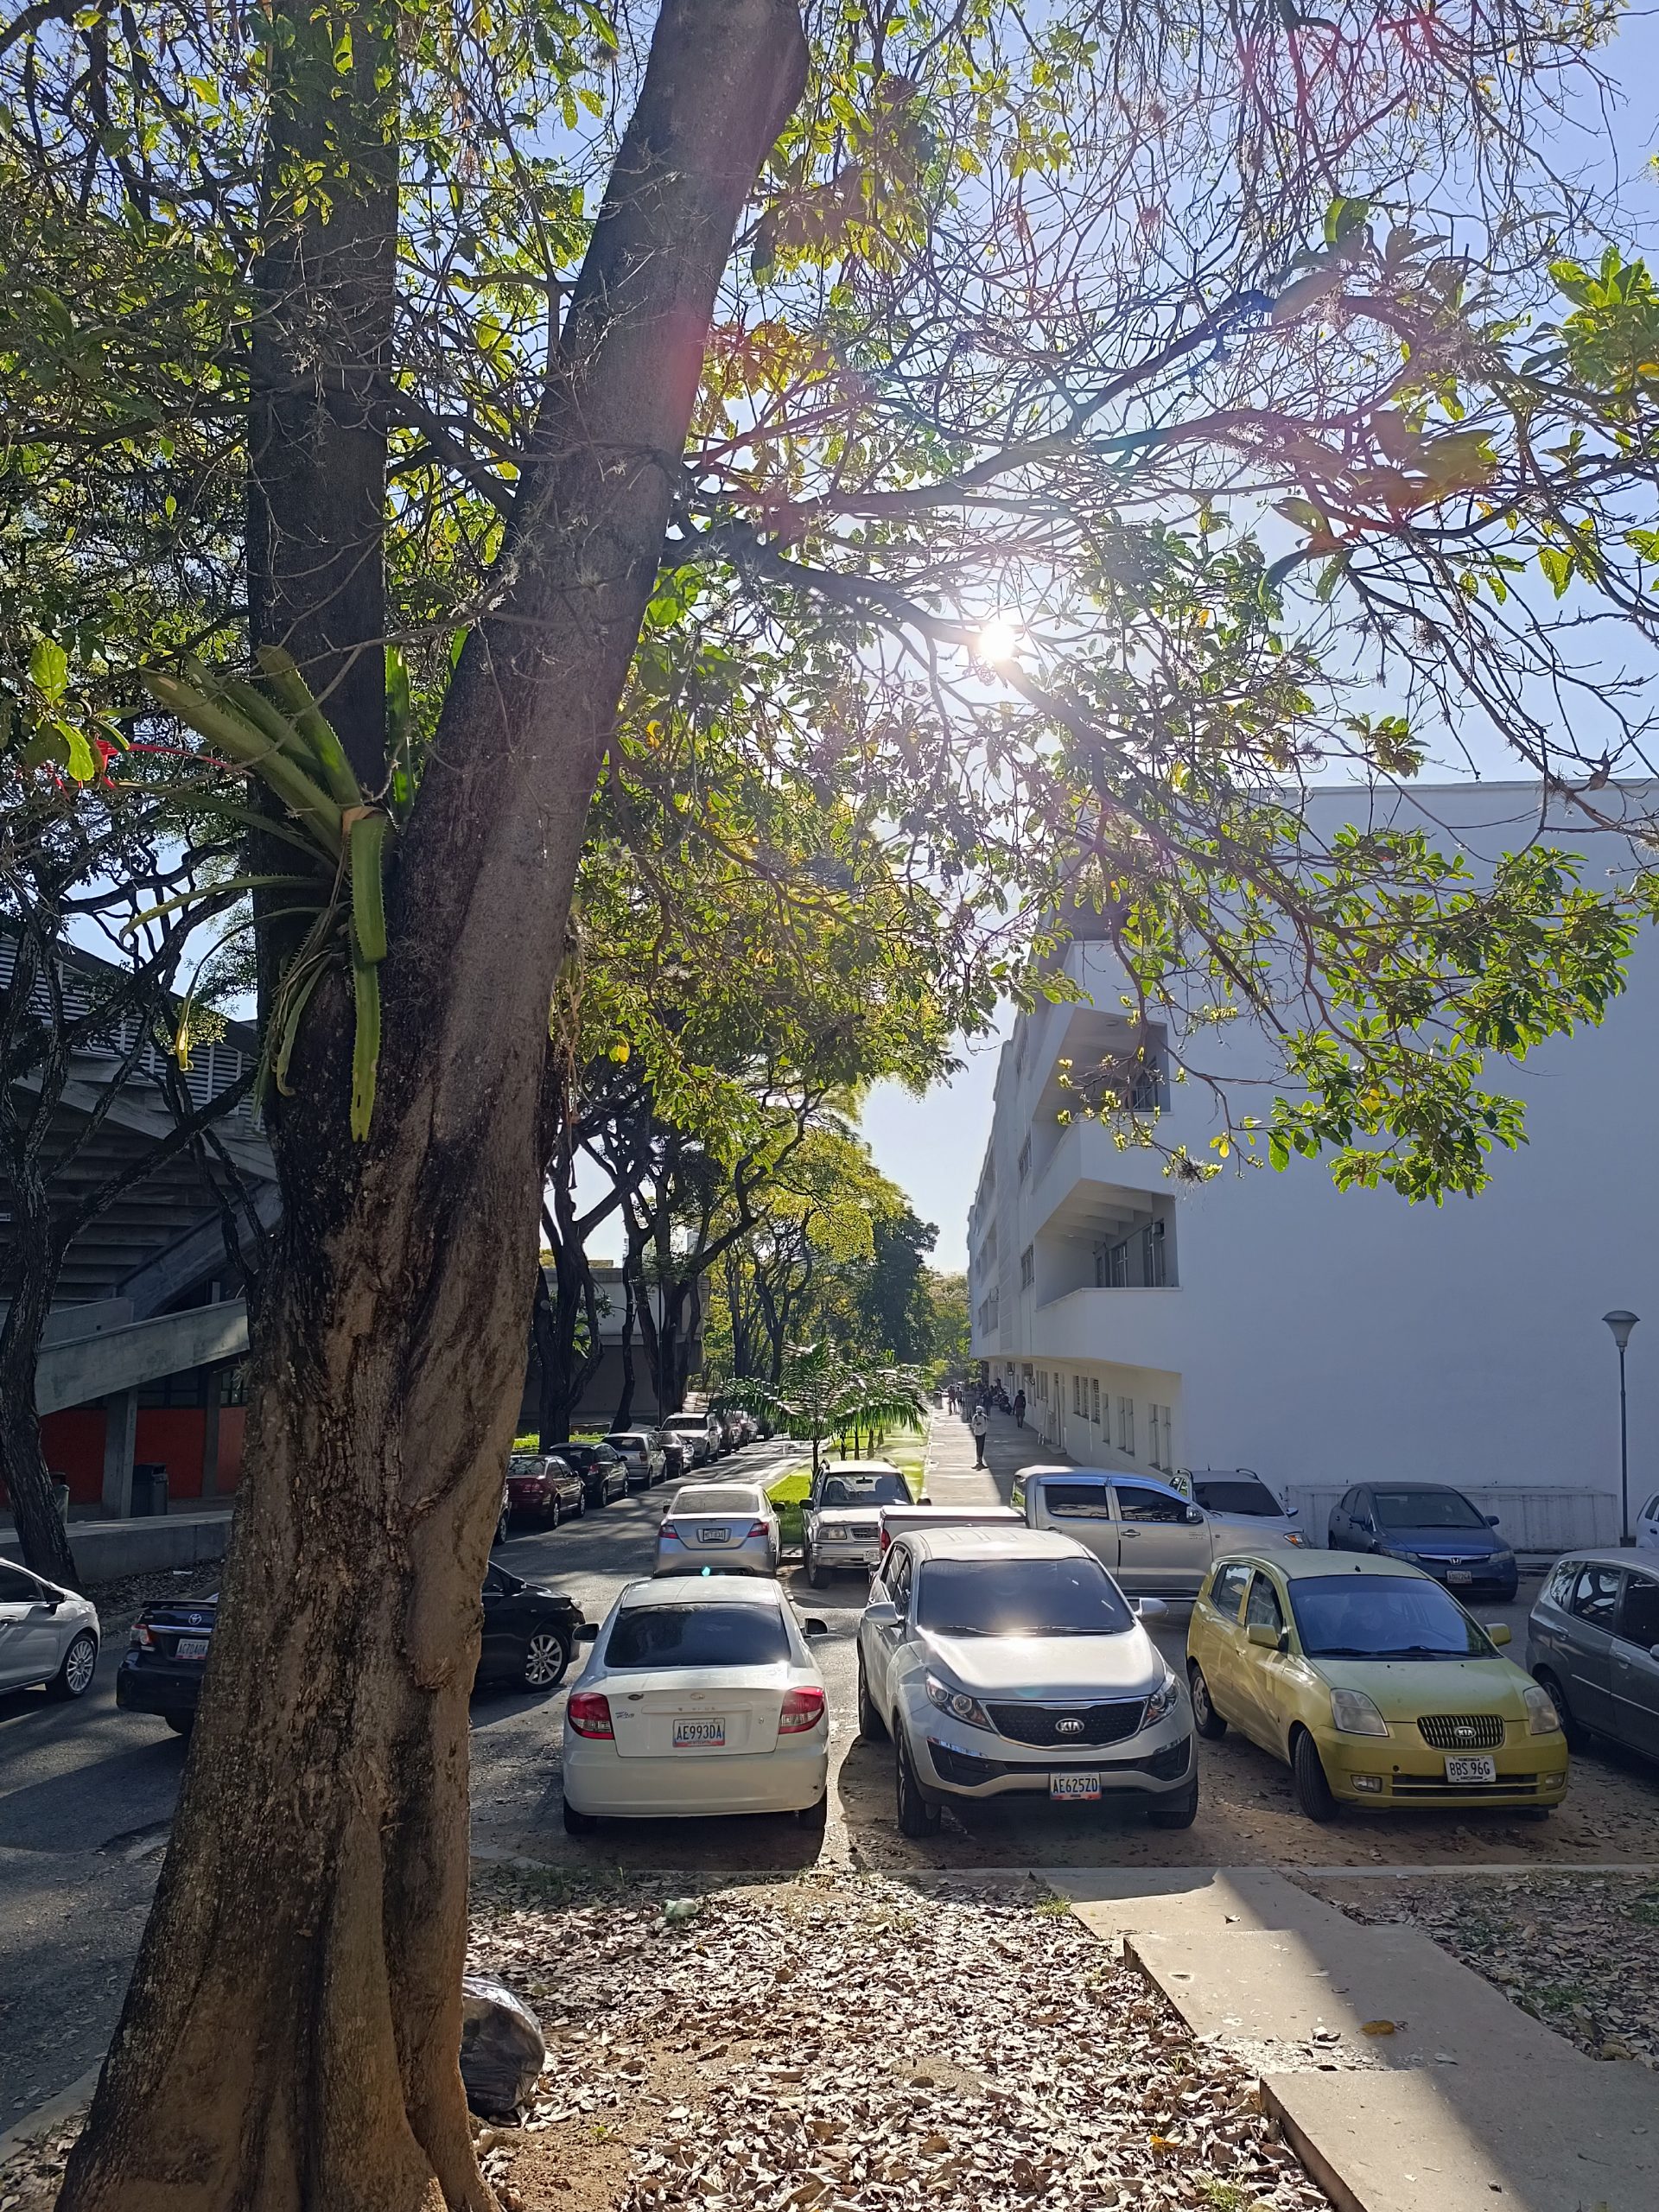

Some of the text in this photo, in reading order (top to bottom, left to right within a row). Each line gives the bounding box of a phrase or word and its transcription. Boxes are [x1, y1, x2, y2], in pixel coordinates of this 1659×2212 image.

[677, 1724, 722, 1740] AE993DA
[1059, 1721, 1080, 1732] KIA
[1449, 1761, 1491, 1776] BBS 96G
[1053, 1777, 1098, 1793] AE625ZD
